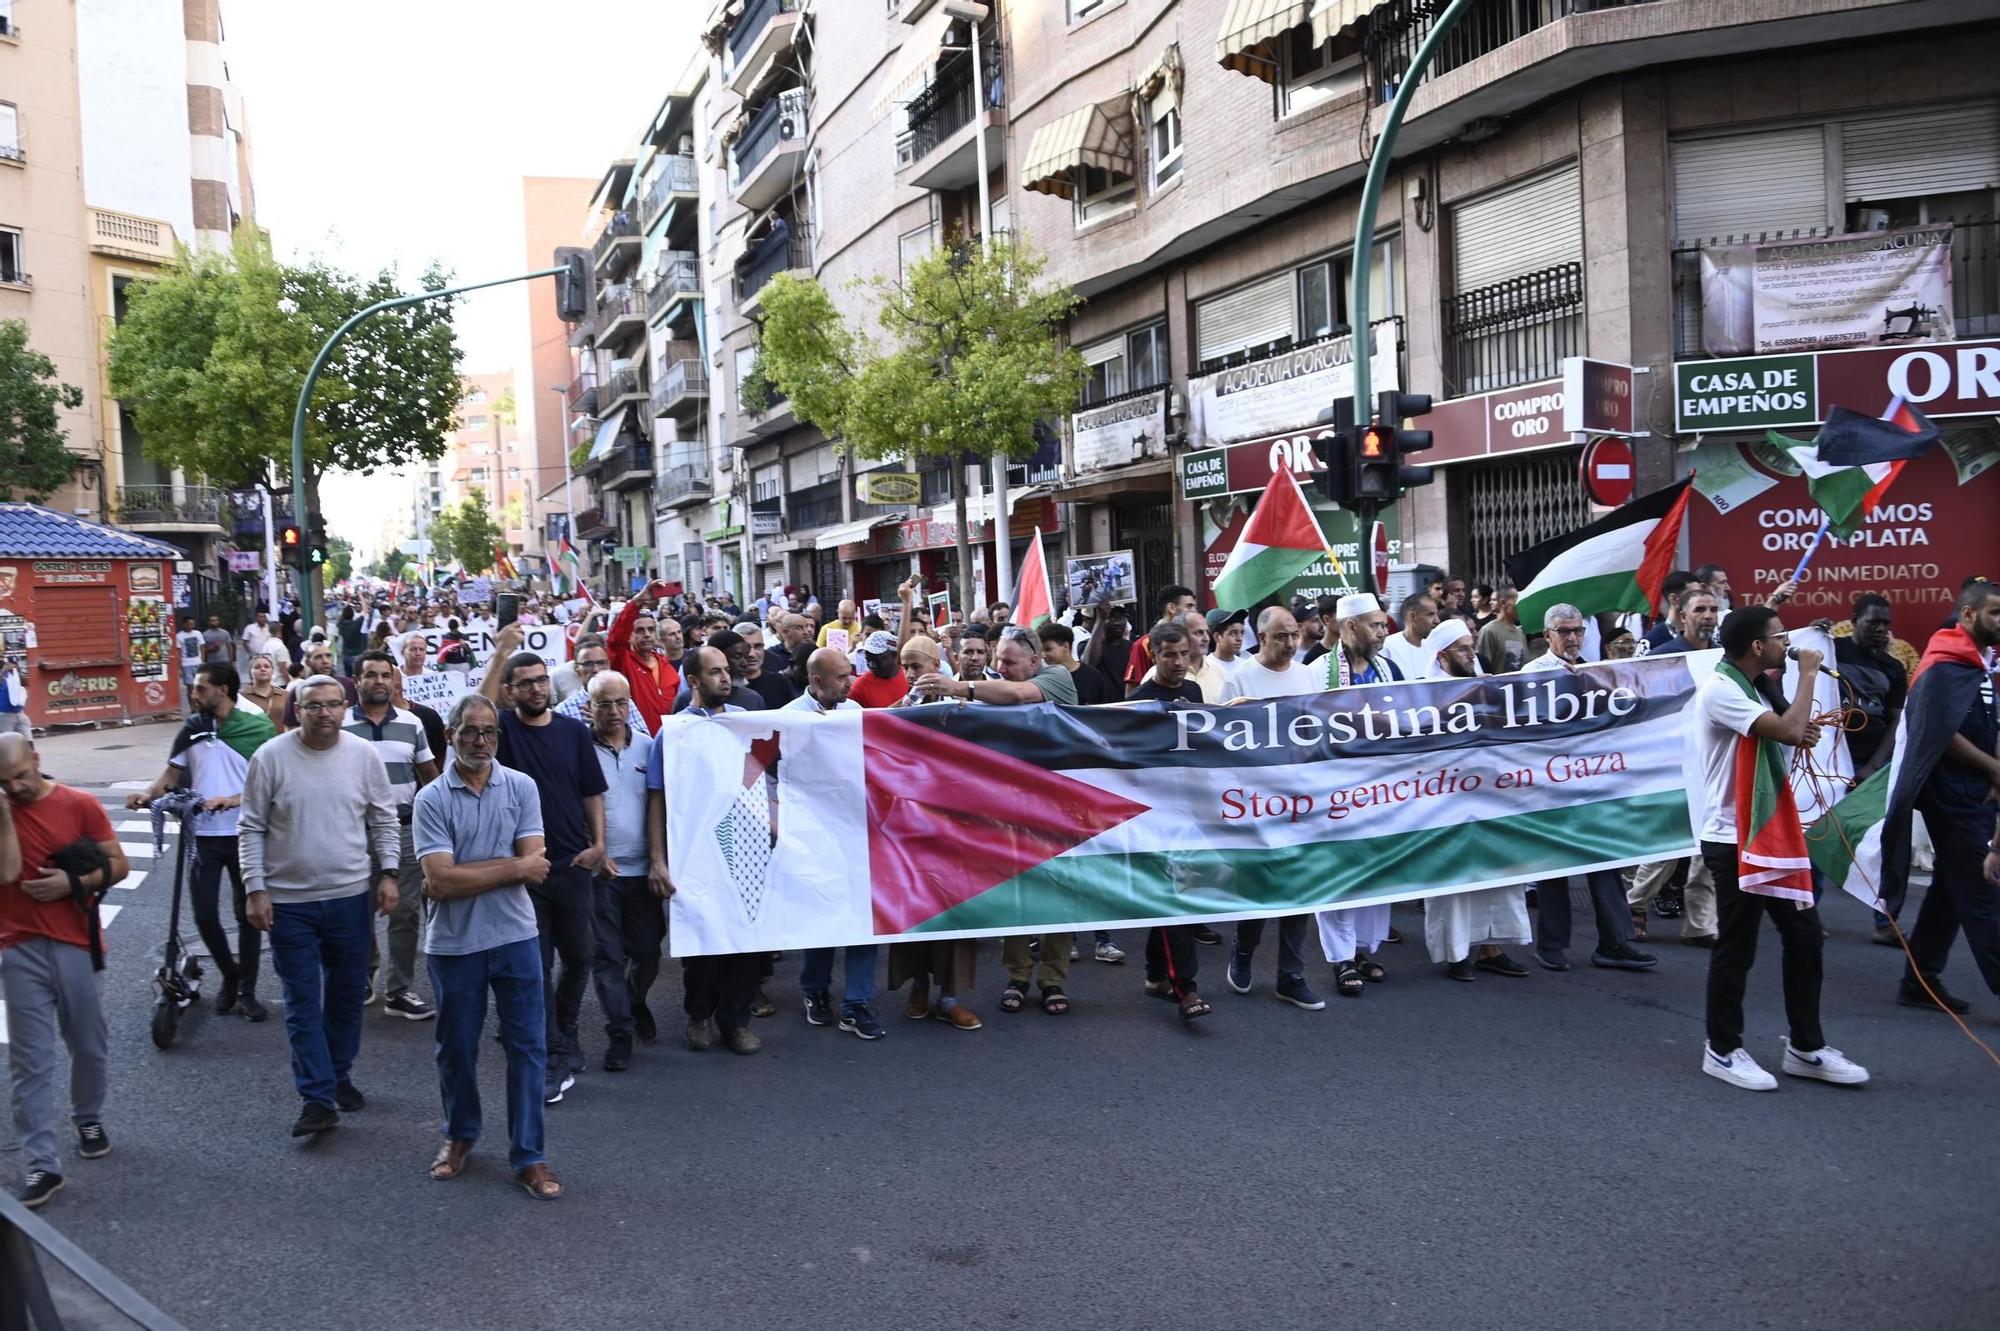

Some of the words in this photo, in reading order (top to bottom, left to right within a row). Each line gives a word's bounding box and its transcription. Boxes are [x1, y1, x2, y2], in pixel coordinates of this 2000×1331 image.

[1768, 240, 1855, 260] ACADEMIA
[1859, 232, 1942, 252] PORCUNA
[1224, 357, 1292, 394] ACADEMIA
[1294, 340, 1354, 375] PORCUN
[1690, 372, 1756, 393] CASA
[1763, 369, 1798, 388] DE
[1494, 392, 1564, 421] COMPRO
[1683, 390, 1807, 416] EMPEÑOS
[1511, 416, 1549, 438] ORO
[1187, 462, 1208, 474] CASA
[1210, 458, 1221, 471] DE
[1185, 473, 1225, 490] EMPEÑOS
[1713, 495, 1730, 510] 100
[1758, 502, 1933, 528] COMMOS
[1762, 531, 1818, 552] ORO
[1849, 527, 1929, 548] PLATA
[1754, 567, 1811, 584] PAGO
[1818, 563, 1939, 582] INMEDIATO
[1168, 695, 1482, 752] Palestina
[1499, 679, 1637, 729] libre
[1221, 788, 1313, 823] Stop
[1328, 768, 1481, 820] gencidio
[1494, 767, 1534, 788] en
[1546, 751, 1627, 783] Gaza
